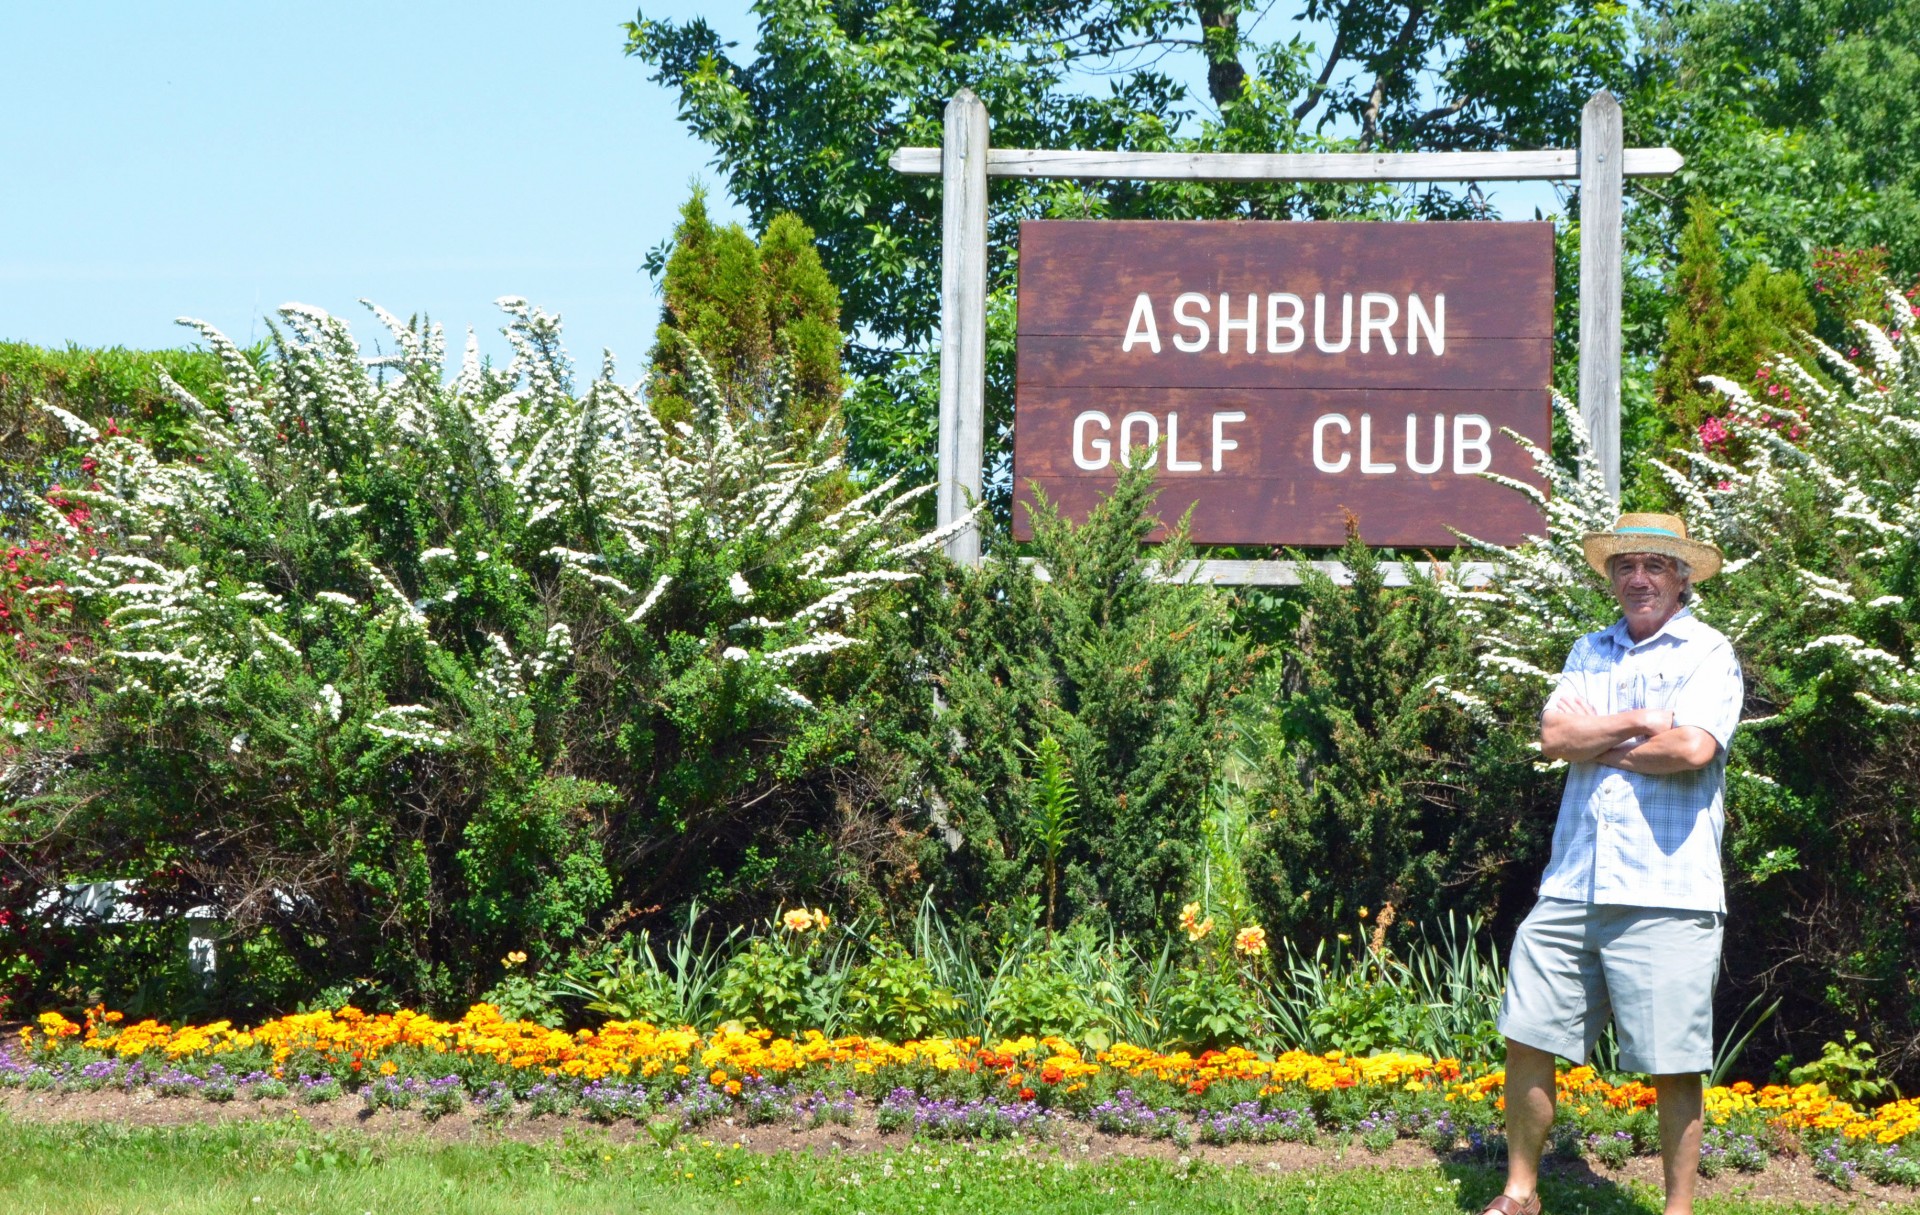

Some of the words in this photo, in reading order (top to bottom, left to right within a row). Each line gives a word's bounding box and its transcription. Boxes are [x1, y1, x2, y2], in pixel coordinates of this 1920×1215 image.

[1122, 291, 1446, 356] ASHBURN
[1072, 410, 1247, 473] GOLF
[1312, 412, 1492, 475] CLUB
